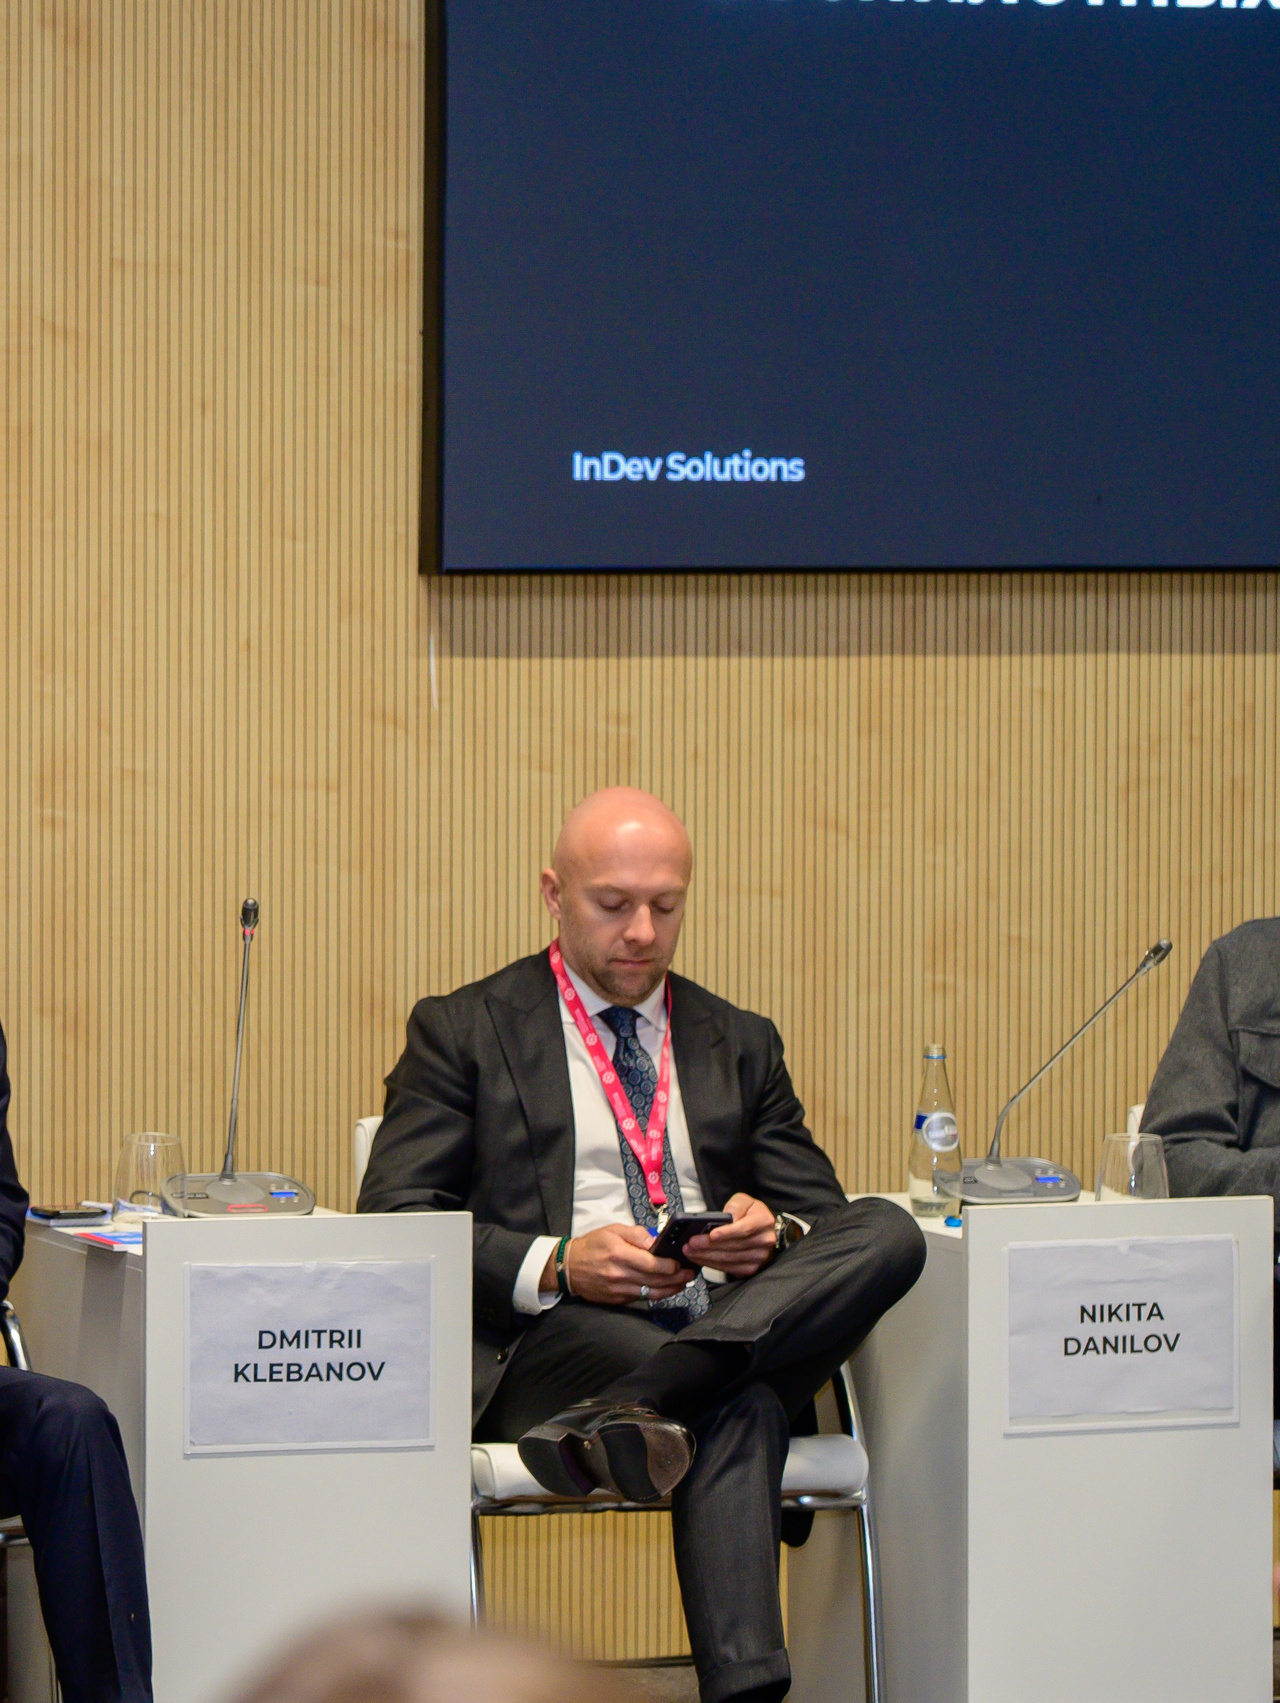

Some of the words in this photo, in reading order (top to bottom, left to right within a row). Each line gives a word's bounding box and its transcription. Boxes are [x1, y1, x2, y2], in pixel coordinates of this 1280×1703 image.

[572, 450, 662, 482] InDev
[666, 447, 806, 482] Solutions
[1079, 1302, 1165, 1324] NIKITA
[257, 1328, 362, 1350] DMITRII
[1062, 1332, 1181, 1357] DANILOV
[233, 1360, 387, 1383] KLEBANOV
